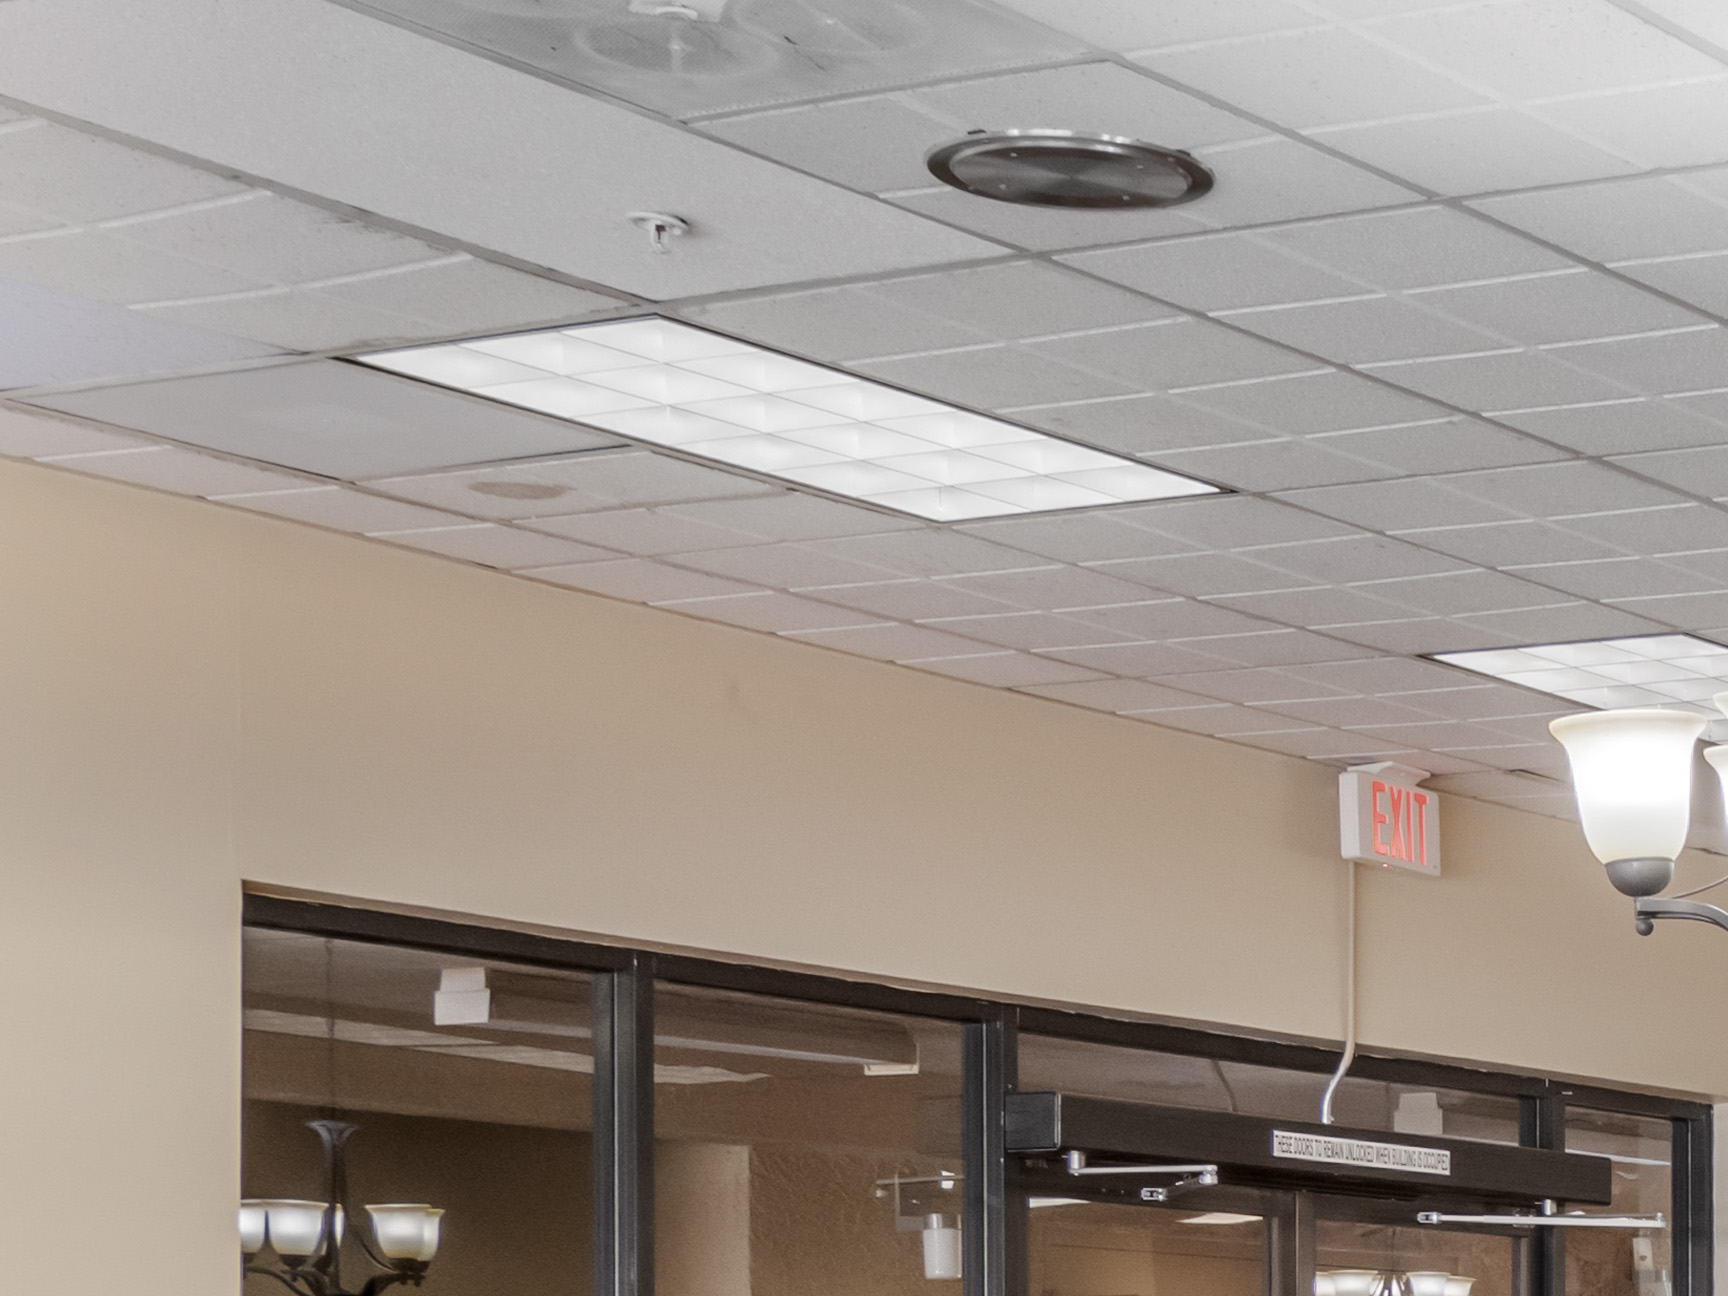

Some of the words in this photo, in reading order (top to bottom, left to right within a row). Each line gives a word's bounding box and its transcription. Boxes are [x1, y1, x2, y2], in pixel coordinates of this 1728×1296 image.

[1372, 780, 1429, 866] EXIT
[1275, 1134, 1293, 1154] THESE
[1294, 1137, 1314, 1156] DOORS
[1314, 1139, 1322, 1157] TO
[1323, 1140, 1345, 1159] REMAIN
[1345, 1143, 1374, 1163] UNLOCKED
[1375, 1146, 1391, 1164] WHEN
[1392, 1148, 1417, 1167] BUILDING
[1423, 1152, 1449, 1171] OCCUPIED
